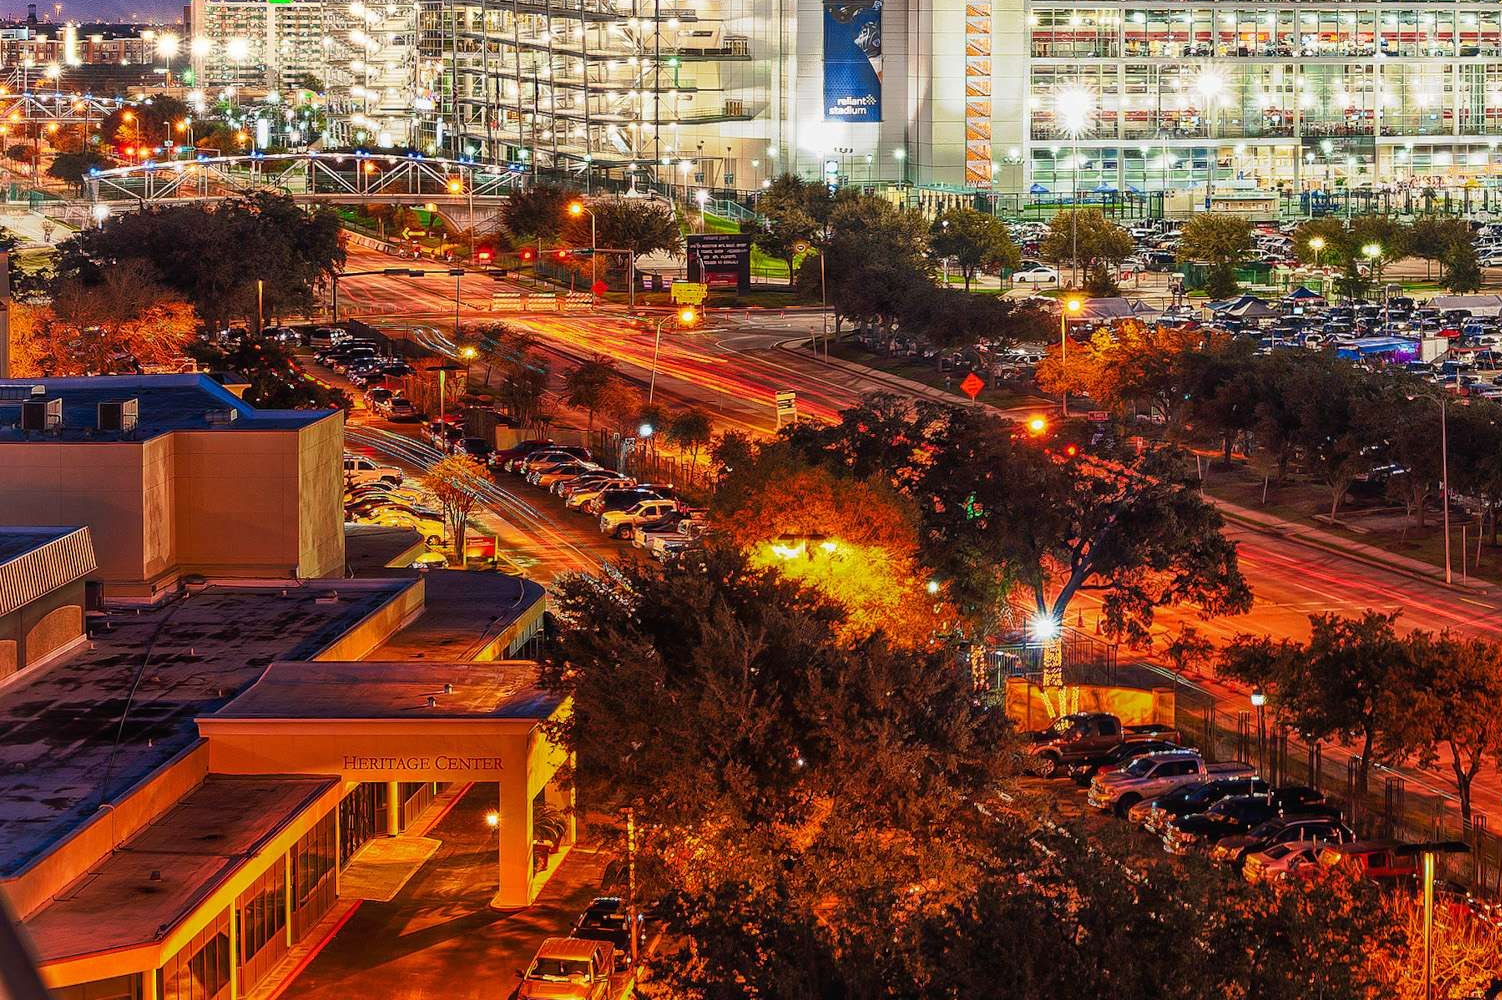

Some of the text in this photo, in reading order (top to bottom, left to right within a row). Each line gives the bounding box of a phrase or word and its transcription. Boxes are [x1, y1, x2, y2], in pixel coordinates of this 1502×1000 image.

[837, 96, 867, 106] reliant
[829, 105, 867, 115] stadium
[343, 755, 504, 770] HERITAGE CENTER
